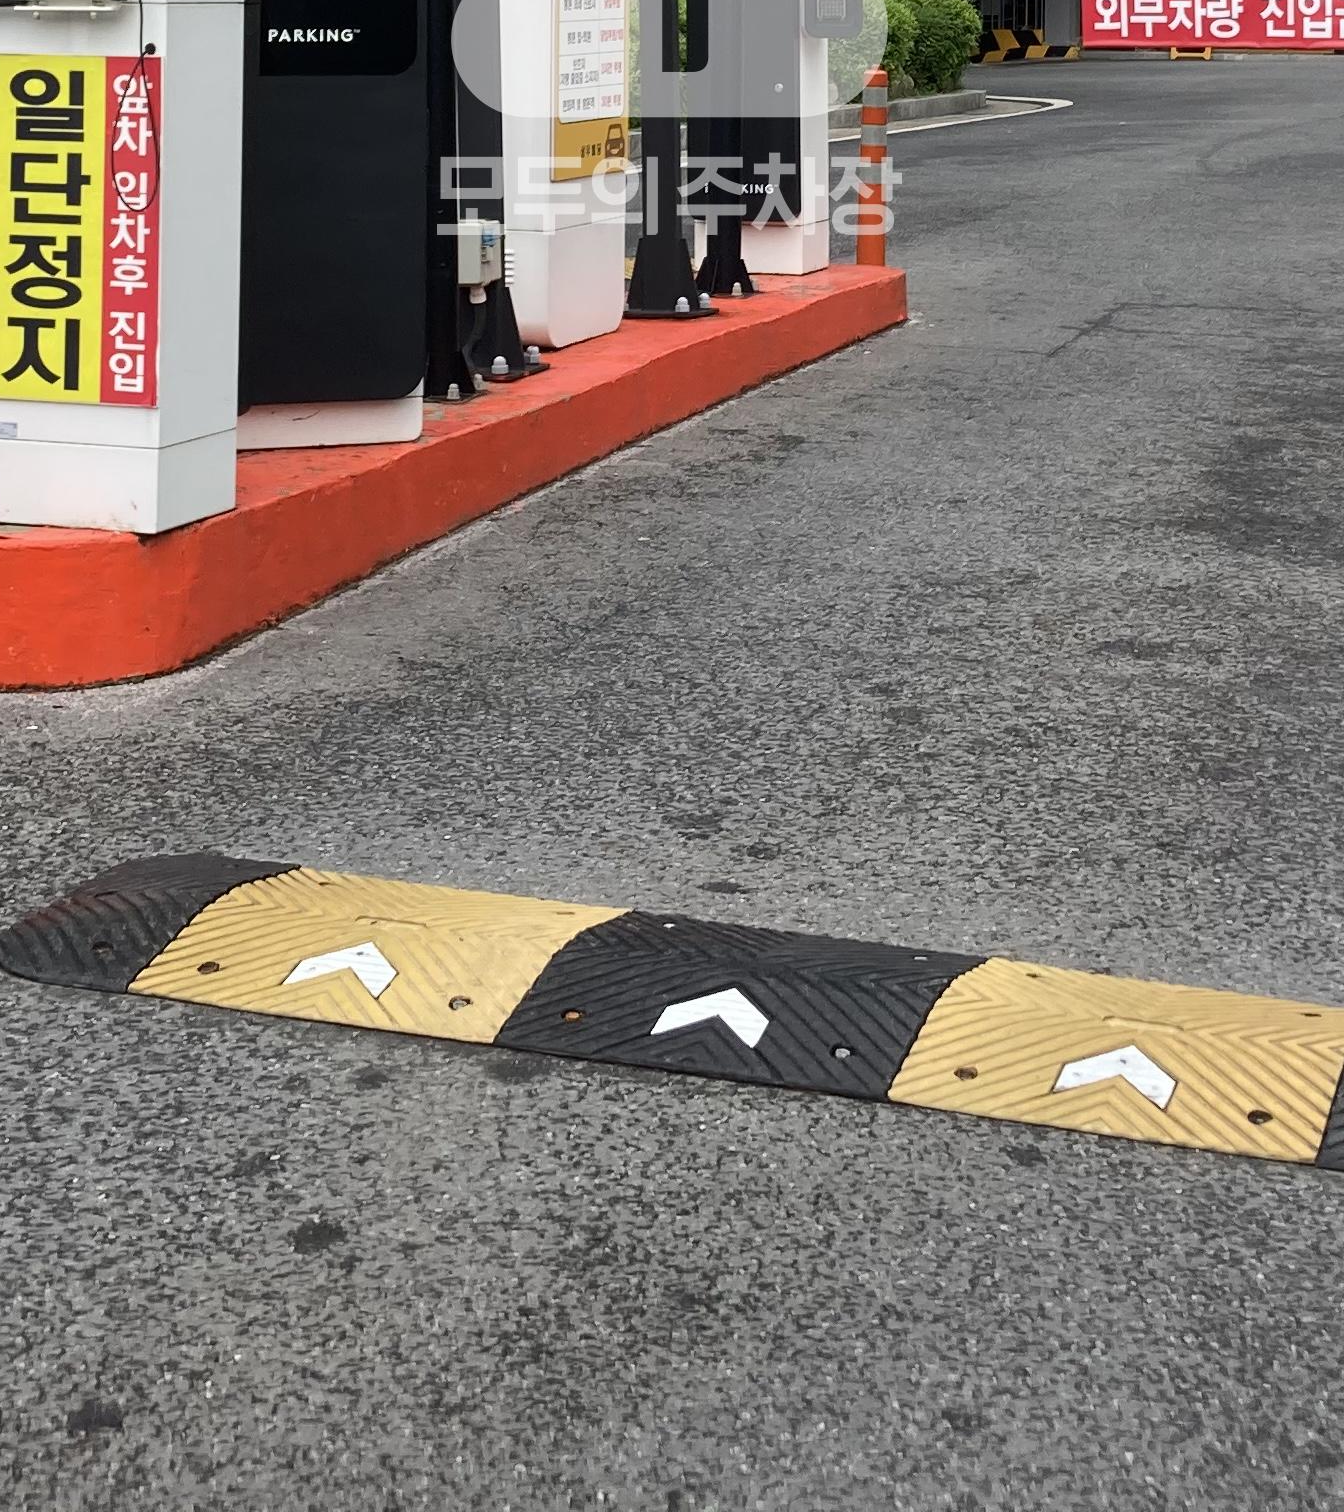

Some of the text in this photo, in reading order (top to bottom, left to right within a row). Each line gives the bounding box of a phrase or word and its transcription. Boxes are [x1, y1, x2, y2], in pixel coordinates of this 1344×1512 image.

[267, 28, 354, 43] PARKING
[1, 69, 91, 391] 일단정지
[108, 74, 153, 393] 앞차 입차후 진입
[741, 183, 775, 194] KING
